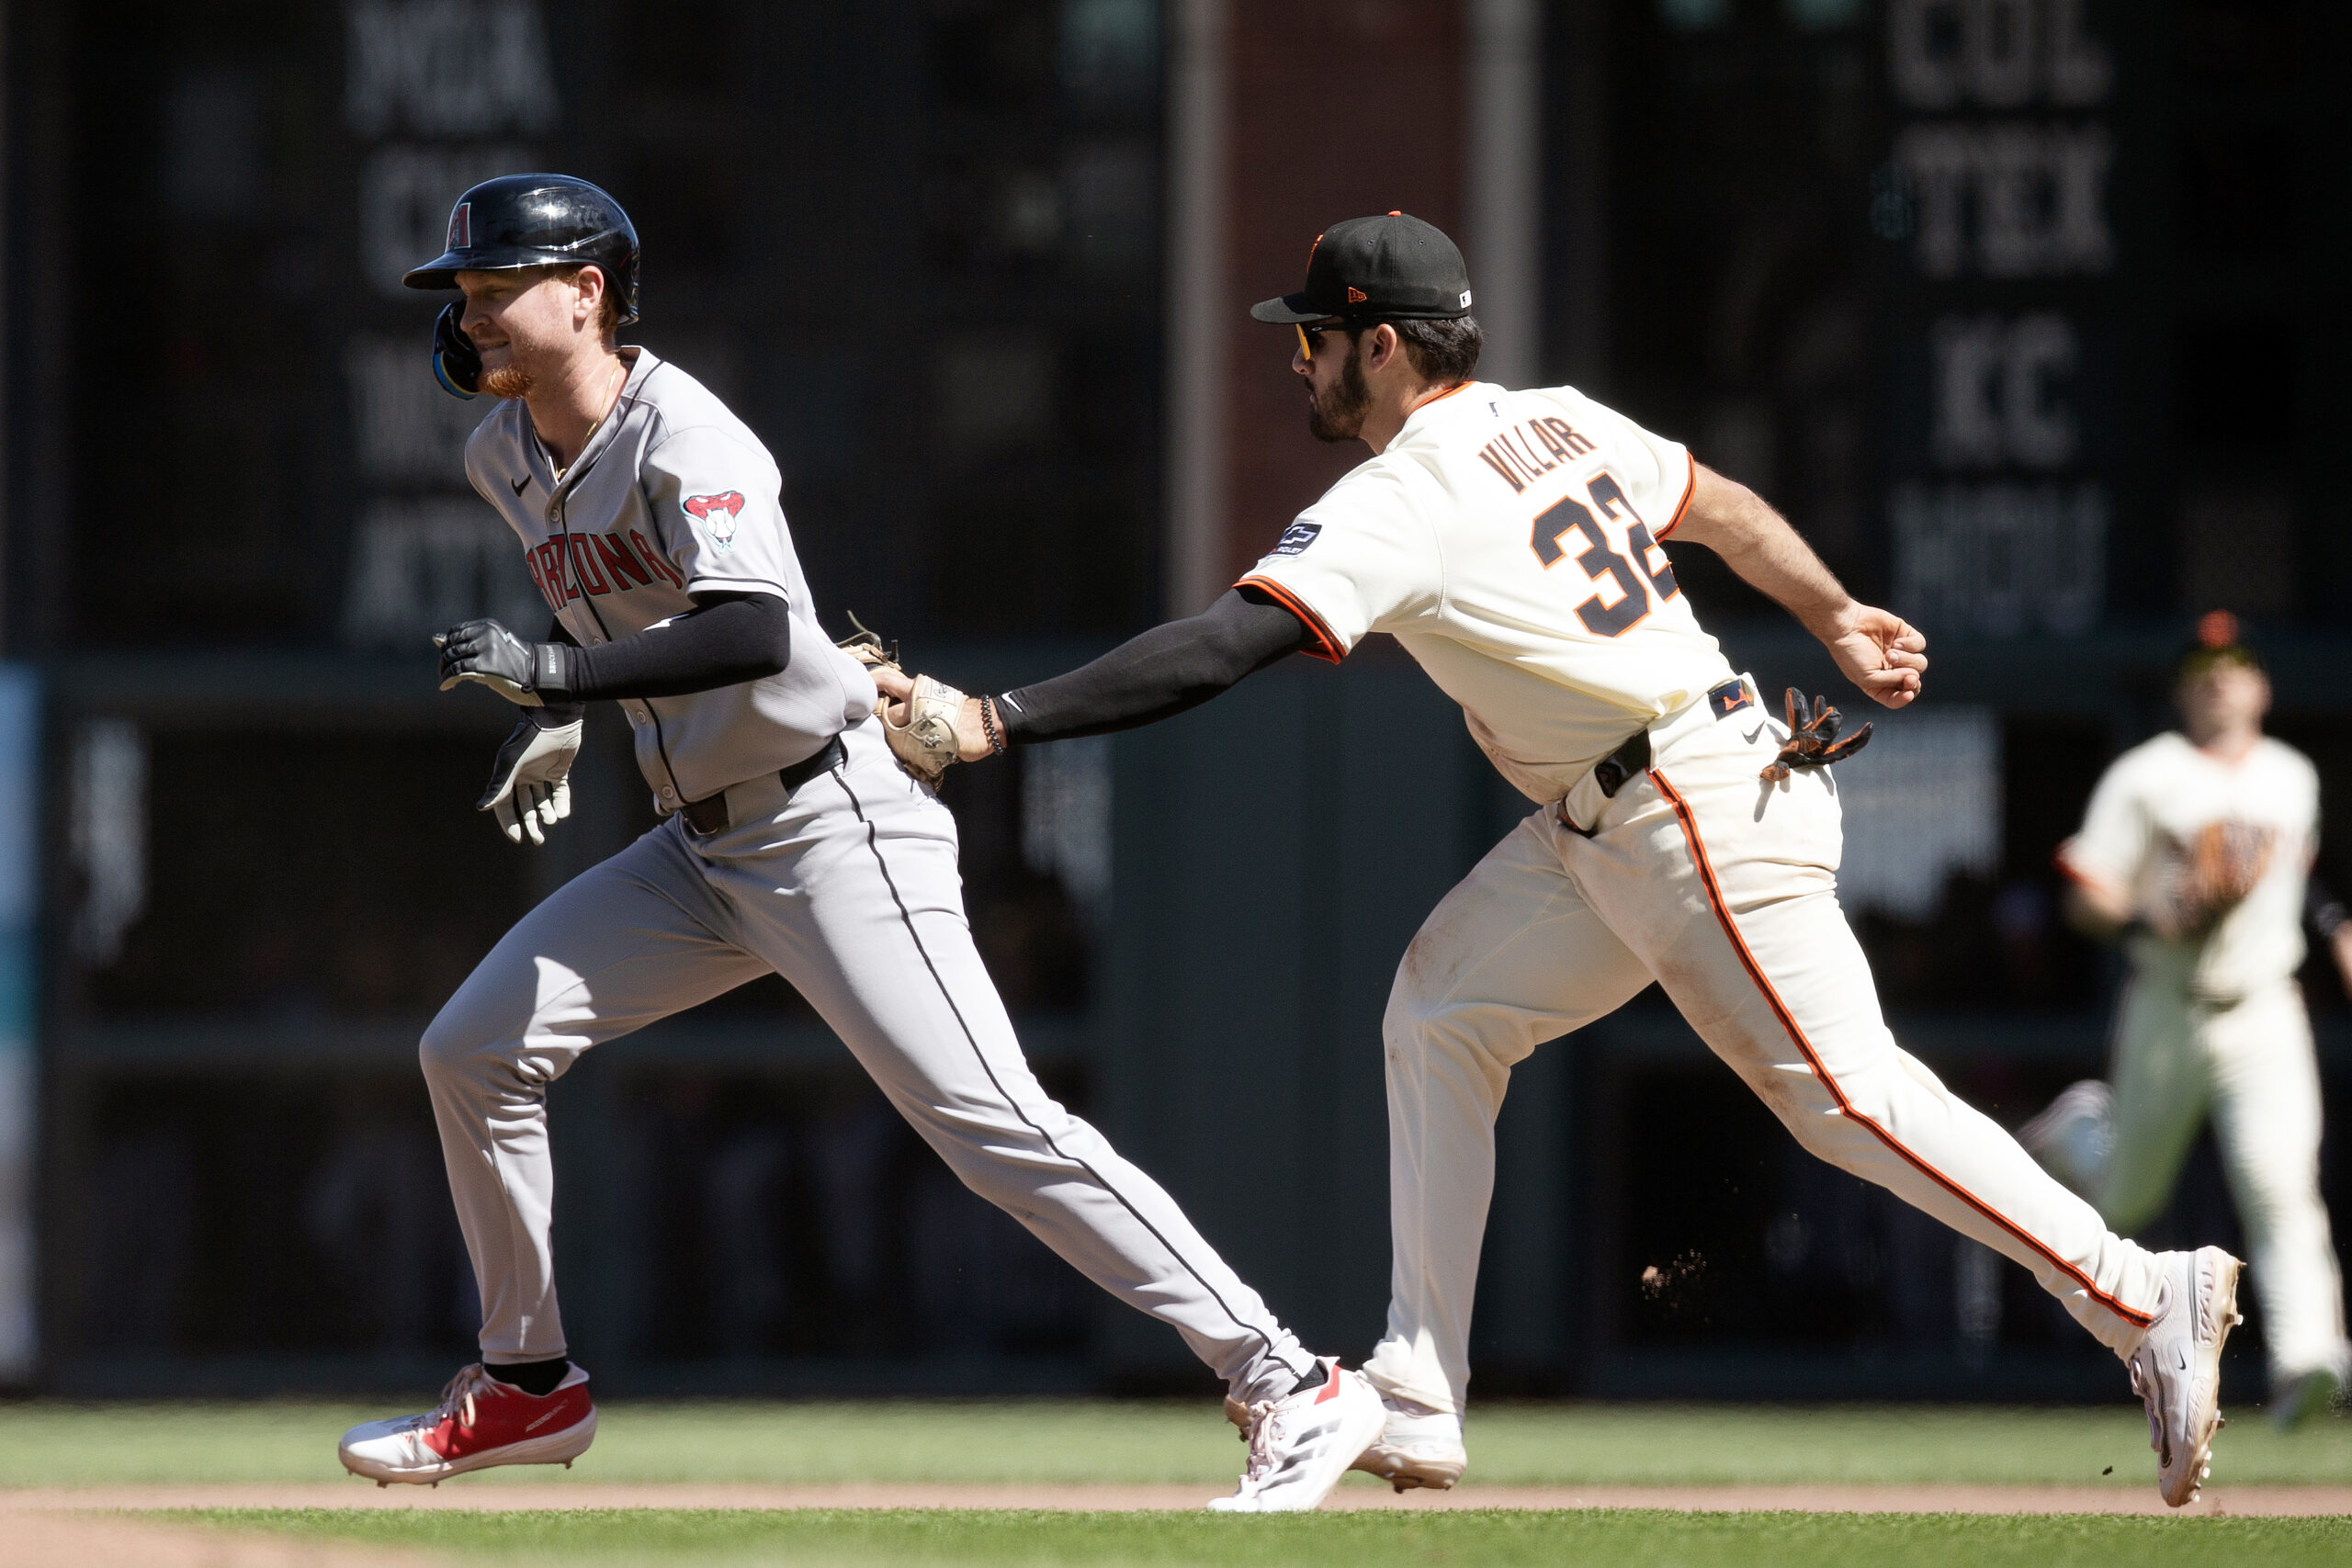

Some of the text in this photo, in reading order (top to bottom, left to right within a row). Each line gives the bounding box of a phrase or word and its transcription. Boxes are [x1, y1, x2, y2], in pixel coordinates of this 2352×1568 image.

[1894, 120, 2114, 276] TEX
[1477, 416, 1598, 495] VILLAR
[1931, 312, 2080, 467] KC
[1530, 470, 1680, 638] 32
